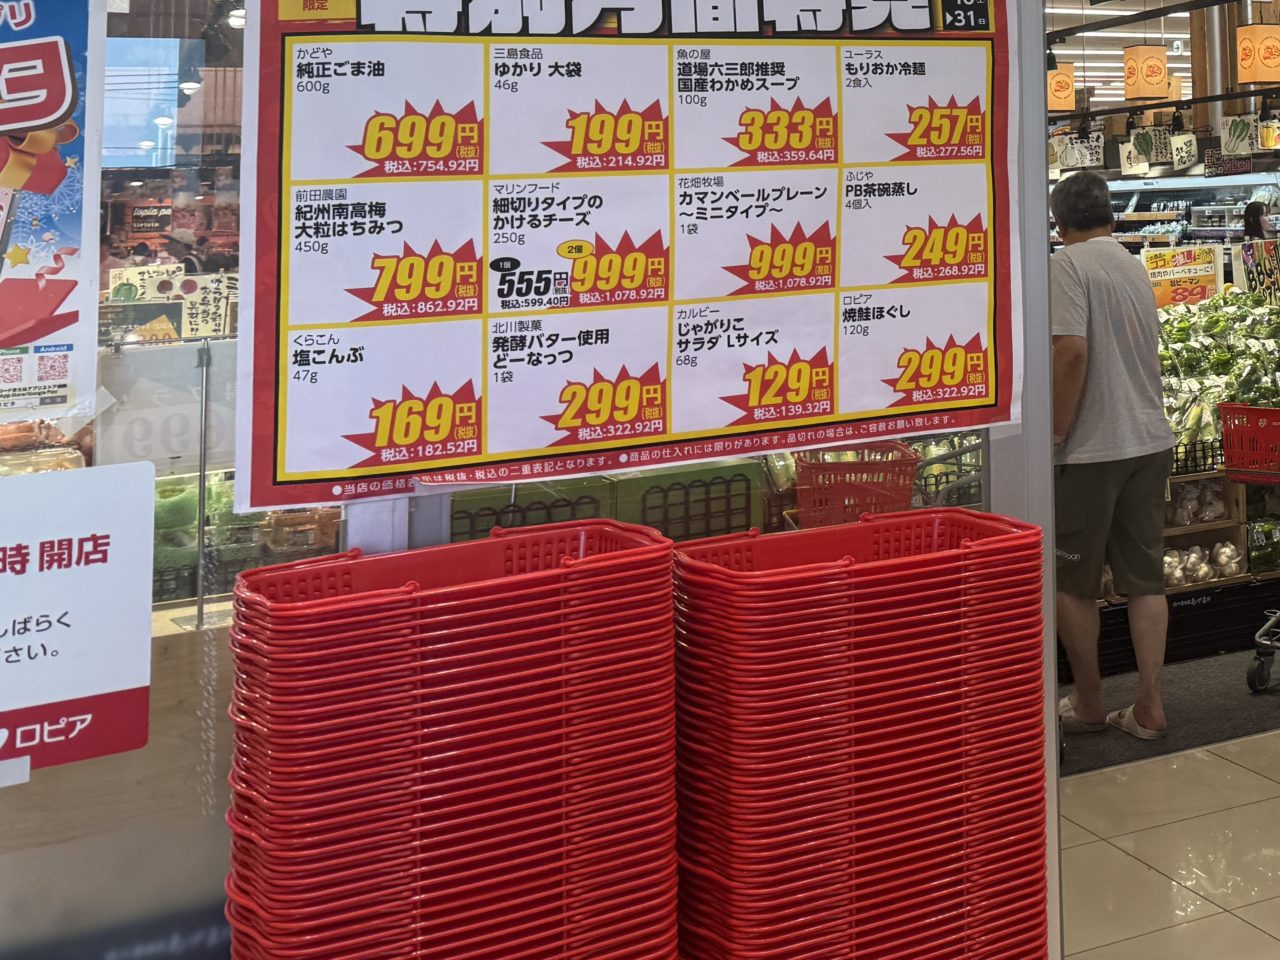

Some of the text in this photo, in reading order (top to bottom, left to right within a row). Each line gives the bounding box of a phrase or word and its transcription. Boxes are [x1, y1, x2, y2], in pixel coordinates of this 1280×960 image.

[303, 0, 328, 11] 限定
[297, 48, 332, 59] かどや
[493, 48, 543, 59] 三島食品
[677, 48, 711, 60] 魚の屋
[845, 49, 883, 60] ユーラス
[297, 61, 385, 78] 純正ごま油
[495, 62, 582, 77] ゆかり 大袋
[678, 62, 786, 77] 道場六三郎推奨
[845, 62, 926, 76] もりおか冷麺
[297, 80, 330, 94] 600g
[495, 80, 518, 92] 46g
[678, 78, 799, 93] 国産わかめスープ
[846, 77, 872, 88] 2食入
[678, 94, 707, 107] 100g
[568, 113, 664, 155] 199円
[737, 109, 834, 151] 333円
[908, 107, 982, 146] 257円
[362, 115, 479, 159] 699円
[757, 150, 834, 162] 税込:359.64円
[917, 145, 983, 158] 税込:277.56円
[384, 159, 479, 173] 税込:754.92円
[576, 155, 665, 168] 税込:214.92円
[678, 176, 724, 188] 花畑牧場
[846, 171, 873, 182] ふじや
[296, 188, 347, 201] 前田農園
[494, 182, 560, 194] マリンフード
[679, 186, 828, 205] カマンベールプレーン
[846, 182, 918, 197] PB茶碗蒸し
[295, 201, 386, 221] 紀州南高梅
[493, 195, 603, 213] 細切りタイプの
[846, 198, 872, 210] 4個入
[493, 211, 592, 230] かけるチーズ
[295, 219, 404, 239] 大粒はちみつ
[680, 223, 698, 235] 1袋
[494, 232, 525, 244] 250g
[295, 240, 329, 255] 450g
[567, 245, 583, 254] 2個
[899, 226, 984, 270] 249円
[749, 242, 831, 280] 999円
[371, 255, 477, 302] 799円
[571, 252, 665, 292] 999円
[913, 264, 985, 279] 税込:268.92円
[755, 275, 831, 290] 税込:1,078.92円
[501, 297, 569, 309] 税込:599.40円
[579, 288, 665, 304] 税込:1,078.92円
[843, 294, 872, 305] ロピア
[382, 298, 478, 317] 税込:862.92円
[678, 307, 720, 319] カルビー
[843, 306, 911, 322] 焼鮭ほぐし
[492, 320, 542, 334] 北川製菓
[678, 317, 744, 337] じゃがりこ
[843, 324, 869, 337] 120g
[293, 333, 340, 346] くらこん
[492, 329, 610, 353] 発酵バター使用
[677, 329, 779, 353] サラダ Lサイズ
[292, 346, 364, 367] 塩こんぶ
[493, 350, 573, 369] どーなっつ
[676, 355, 698, 368] 68g
[293, 370, 317, 383] 47g
[494, 371, 513, 383] 1袋
[896, 348, 983, 392] 299円
[743, 362, 829, 407] 129円
[913, 385, 985, 401] 税込:322.92円
[557, 379, 662, 429] 299円
[754, 400, 830, 419] 税込:139.32円
[370, 397, 477, 447] 169円
[578, 420, 663, 440] 税込:322.92円
[381, 440, 477, 461] 税込:182.52円
[39, 534, 111, 572] 開店
[16, 713, 92, 749] ロピア
